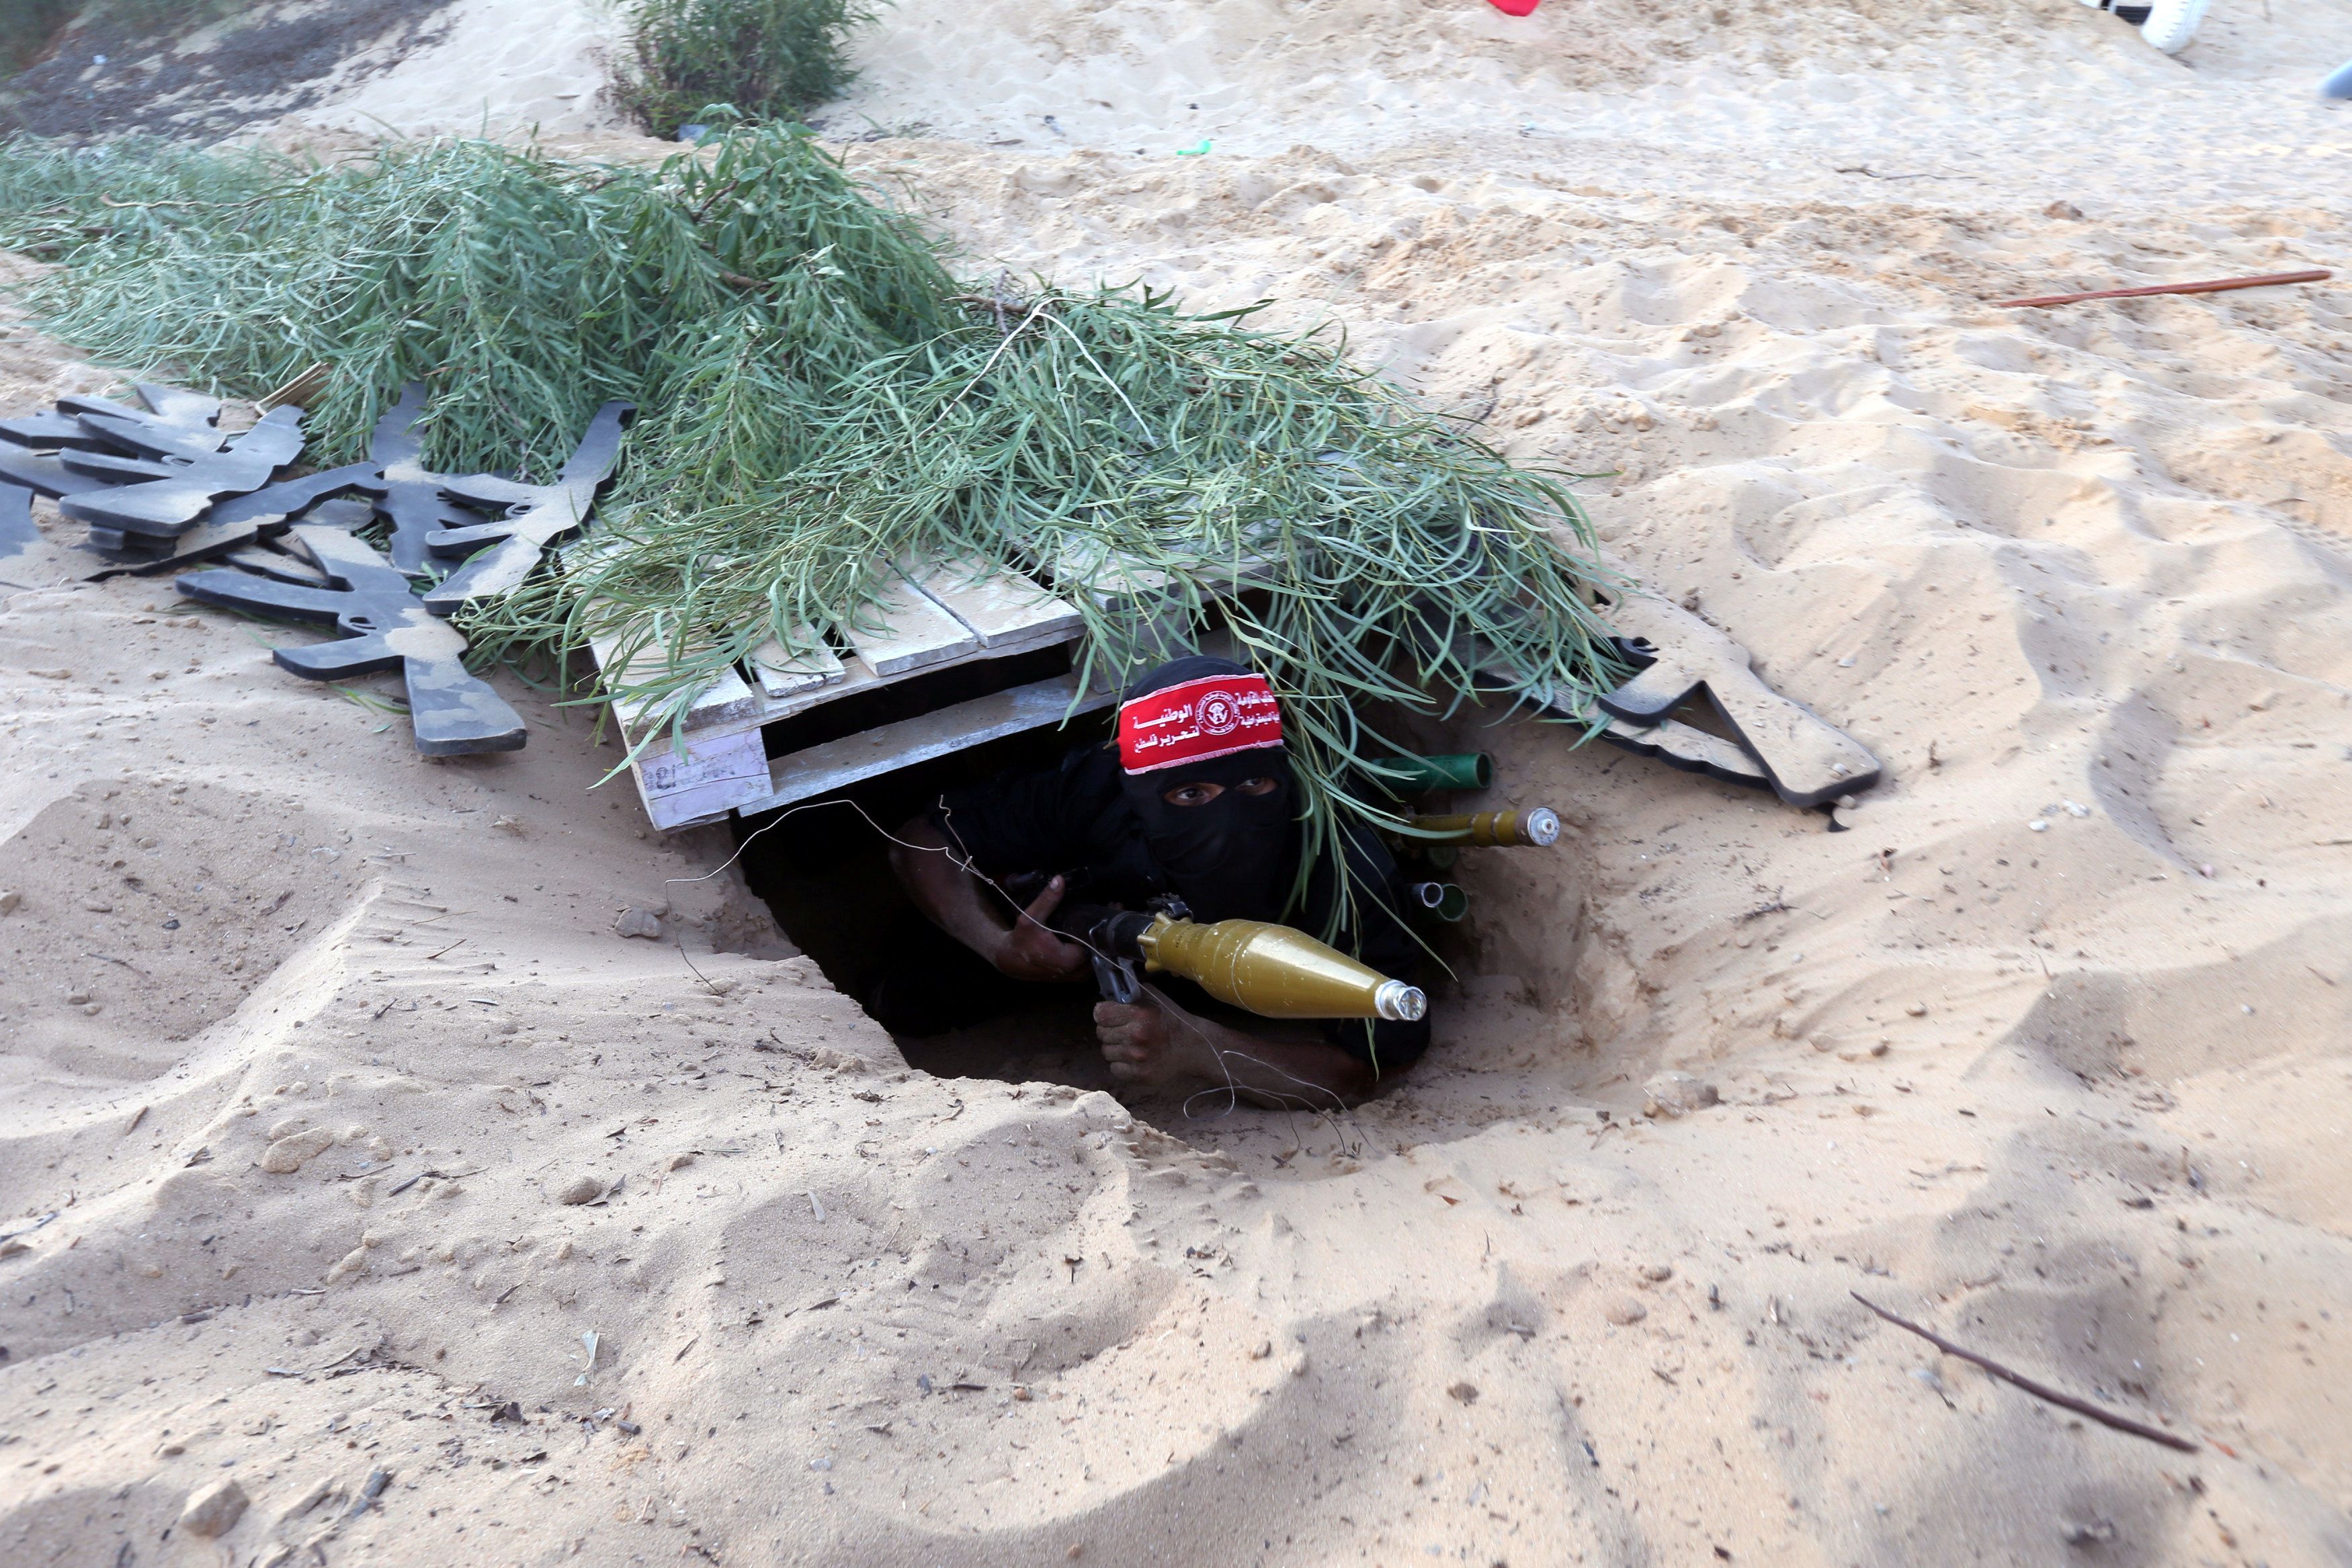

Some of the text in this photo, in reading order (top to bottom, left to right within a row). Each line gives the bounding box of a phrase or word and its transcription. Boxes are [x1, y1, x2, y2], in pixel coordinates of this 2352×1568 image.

[1132, 703, 1193, 729] الوطنية
[1134, 734, 1158, 753] فلسطين
[1159, 726, 1200, 747] لتحرير
